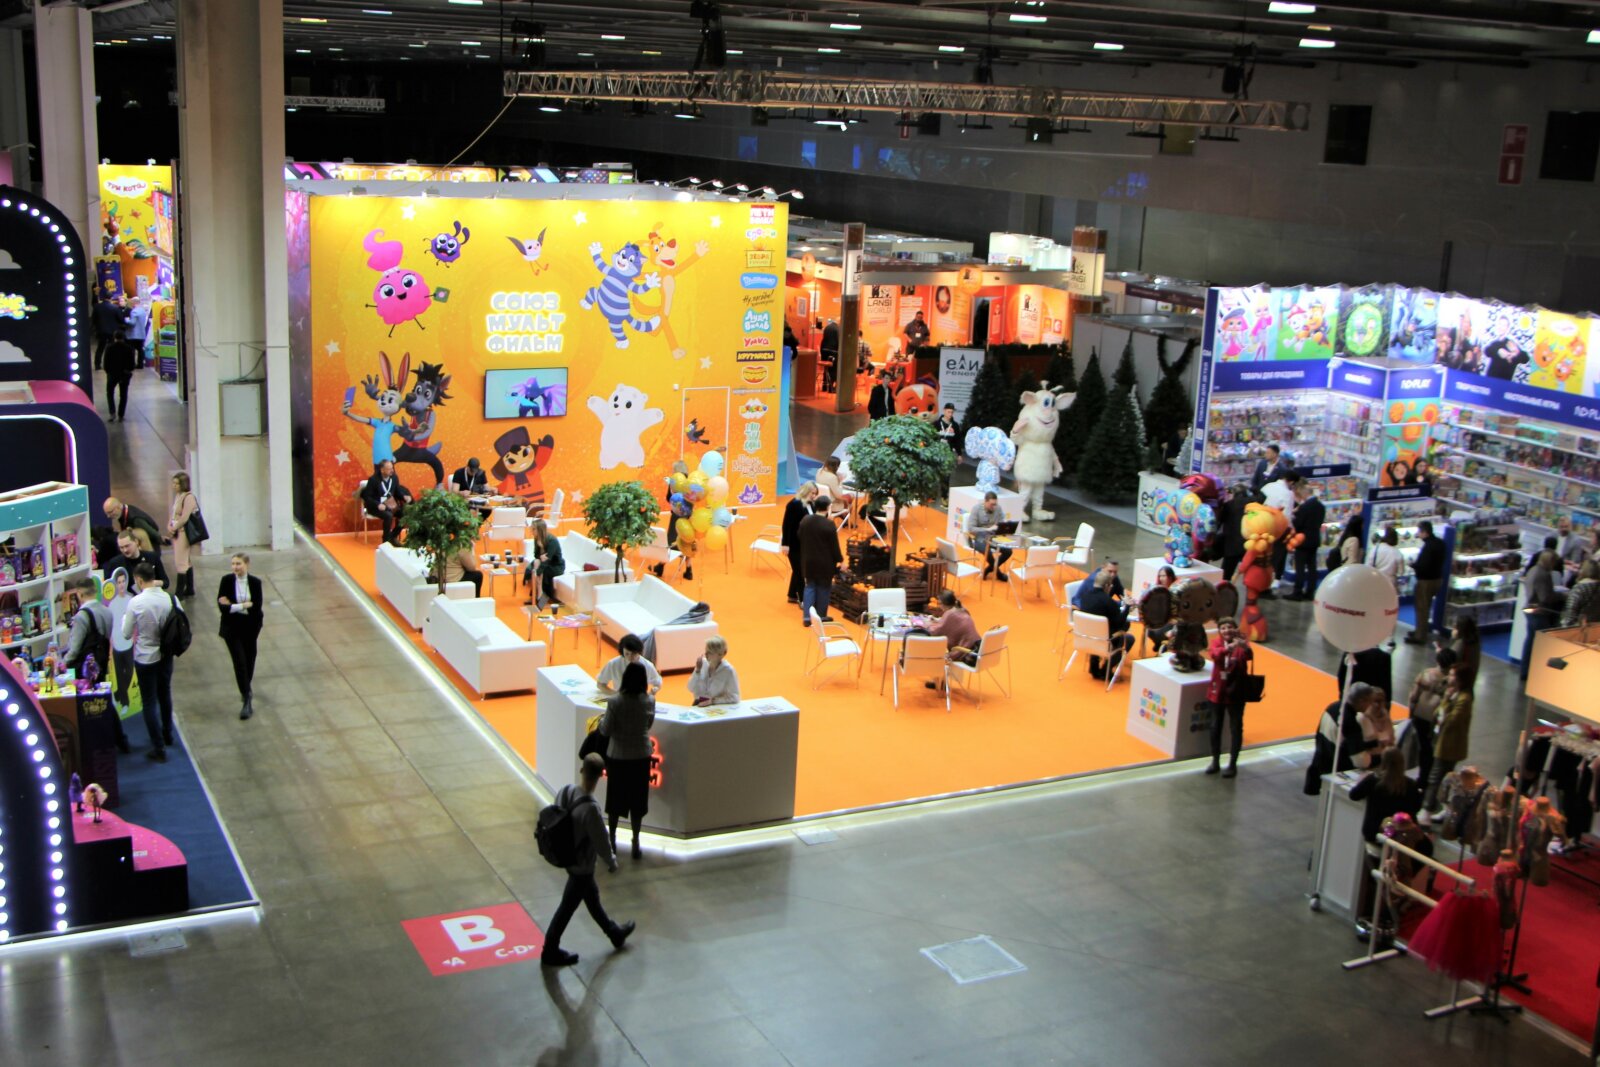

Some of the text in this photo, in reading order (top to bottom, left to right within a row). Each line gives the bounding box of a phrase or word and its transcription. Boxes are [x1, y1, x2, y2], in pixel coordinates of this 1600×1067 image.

[492, 292, 560, 311] СОЮЗ
[867, 299, 892, 307] LANSI
[487, 313, 565, 333] МУЛЬТ
[487, 334, 563, 353] ФИЛЬМ
[440, 915, 506, 952] B
